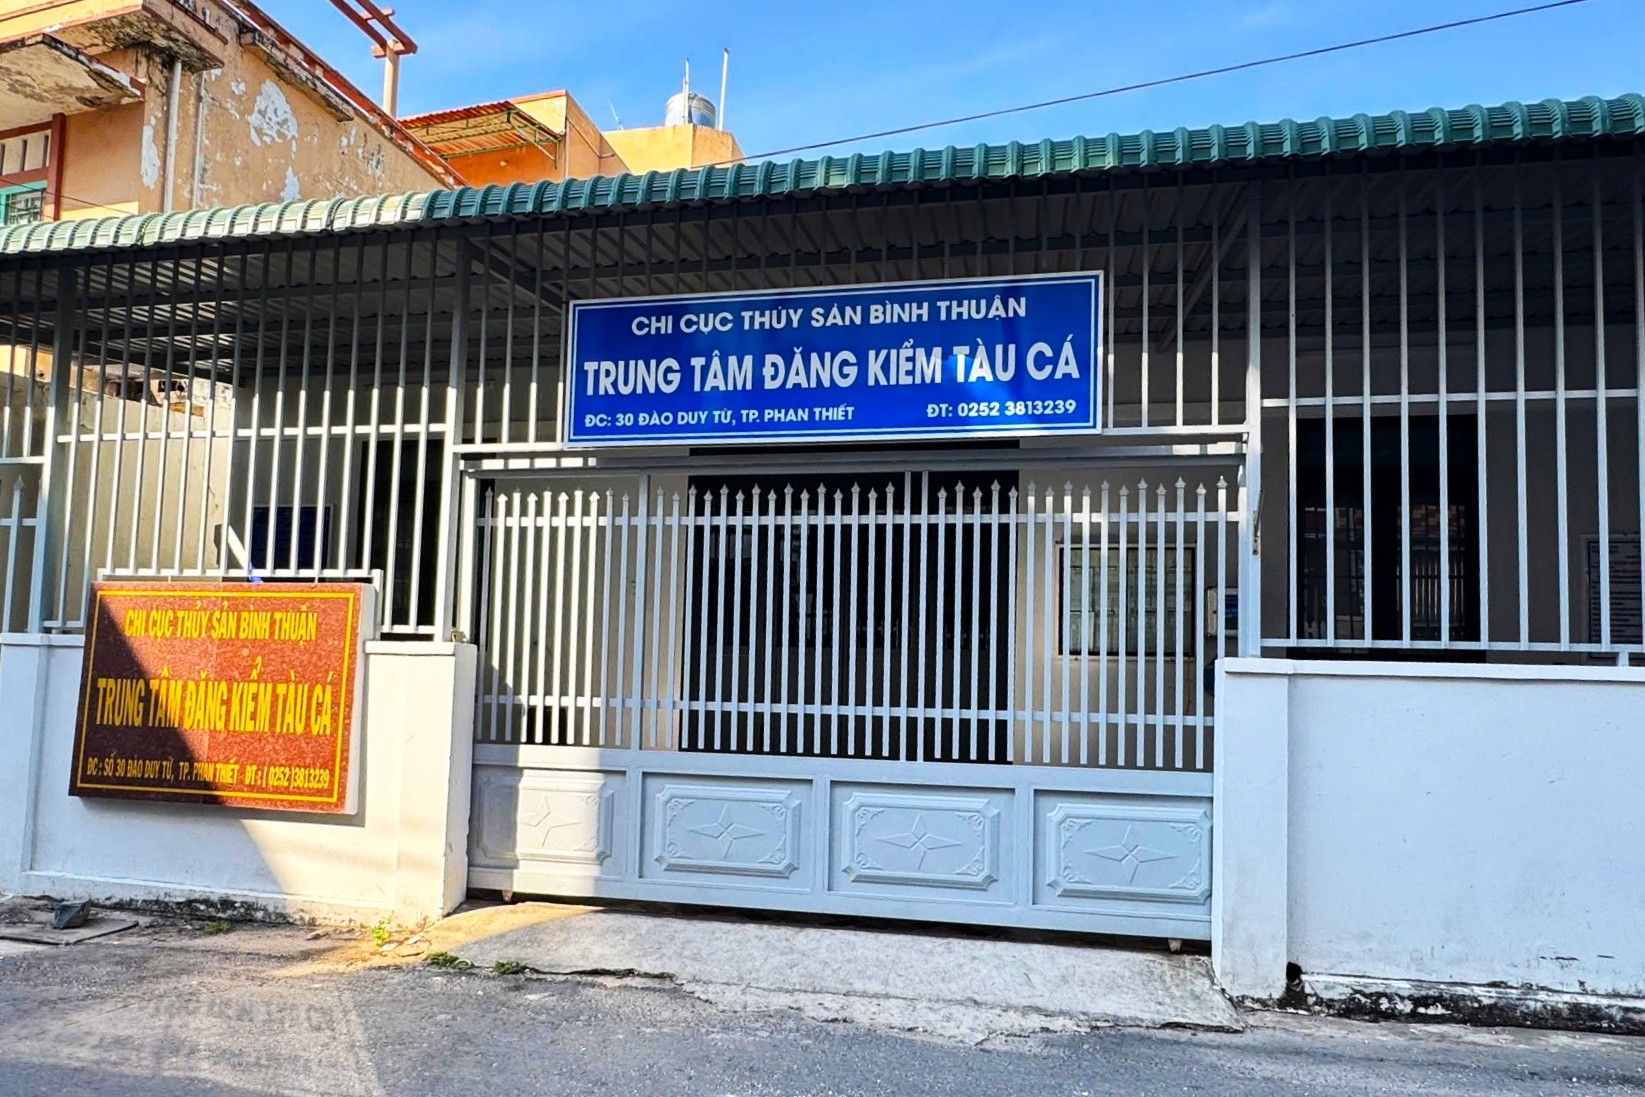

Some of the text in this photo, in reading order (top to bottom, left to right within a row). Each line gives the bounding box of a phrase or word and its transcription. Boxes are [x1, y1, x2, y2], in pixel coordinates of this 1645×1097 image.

[631, 294, 1026, 336] CHI CỤC THỦY SẢN BÌNH THUẬN
[583, 333, 1081, 396] TRUNG TÂM ĐĂNG KIỂM TÀU CÁ
[584, 398, 1077, 428] ĐC: 30 ĐÀO DUY TỪ, TP. PHAN THIẾT ĐT: 0252 3813239
[124, 600, 318, 646] CHI CỤC THỦY SẢN BÌNH THUẬN
[95, 655, 333, 736] TRUNG TÂM ĐĂNG KIỂM TÀU CÁ
[103, 749, 116, 777] SỐ
[115, 758, 126, 777] 30
[144, 759, 161, 779] DUY
[178, 761, 191, 781] TP.
[192, 761, 215, 782] PHAN
[215, 757, 239, 784] THIẾT
